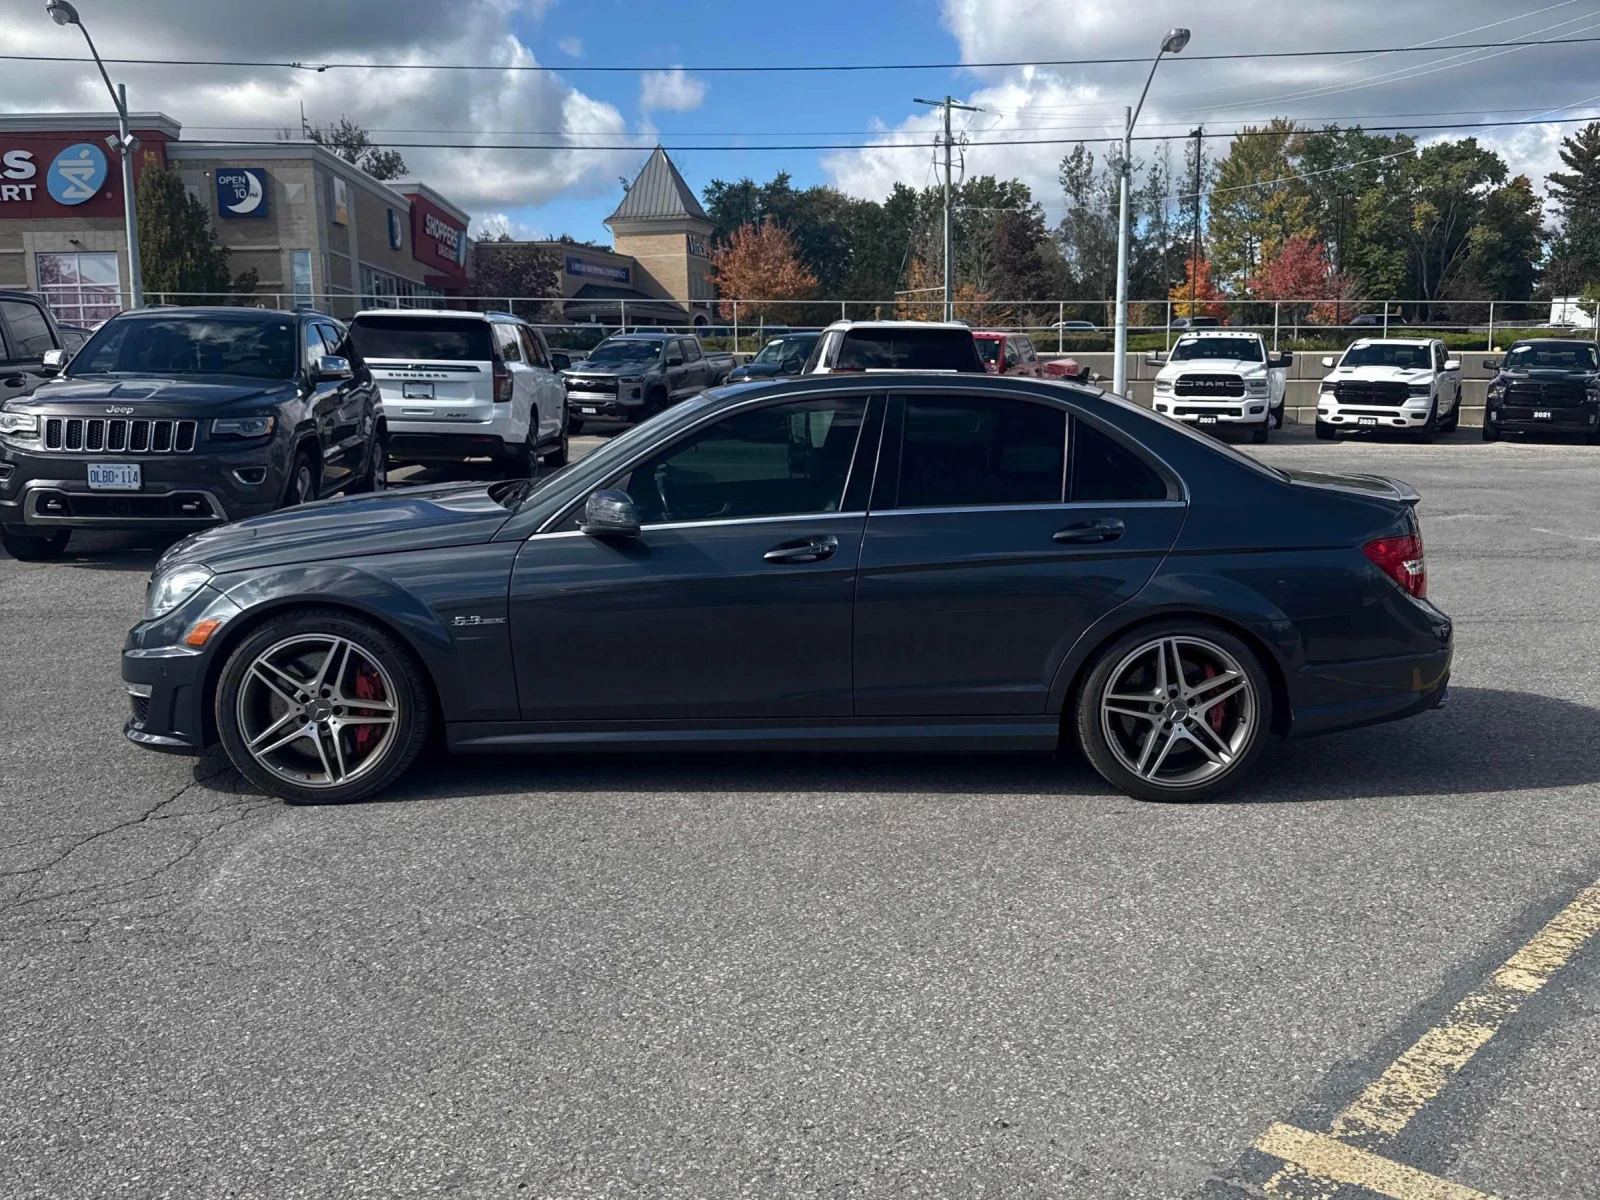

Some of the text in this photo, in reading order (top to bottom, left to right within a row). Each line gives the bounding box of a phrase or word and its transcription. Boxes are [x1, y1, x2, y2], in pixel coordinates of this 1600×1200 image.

[0, 149, 37, 180] S
[218, 175, 246, 185] OPEN
[0, 184, 37, 202] RT
[234, 188, 247, 199] 10
[425, 213, 459, 249] SHOPPERS
[105, 405, 134, 415] Jeep
[121, 470, 139, 483] 114
